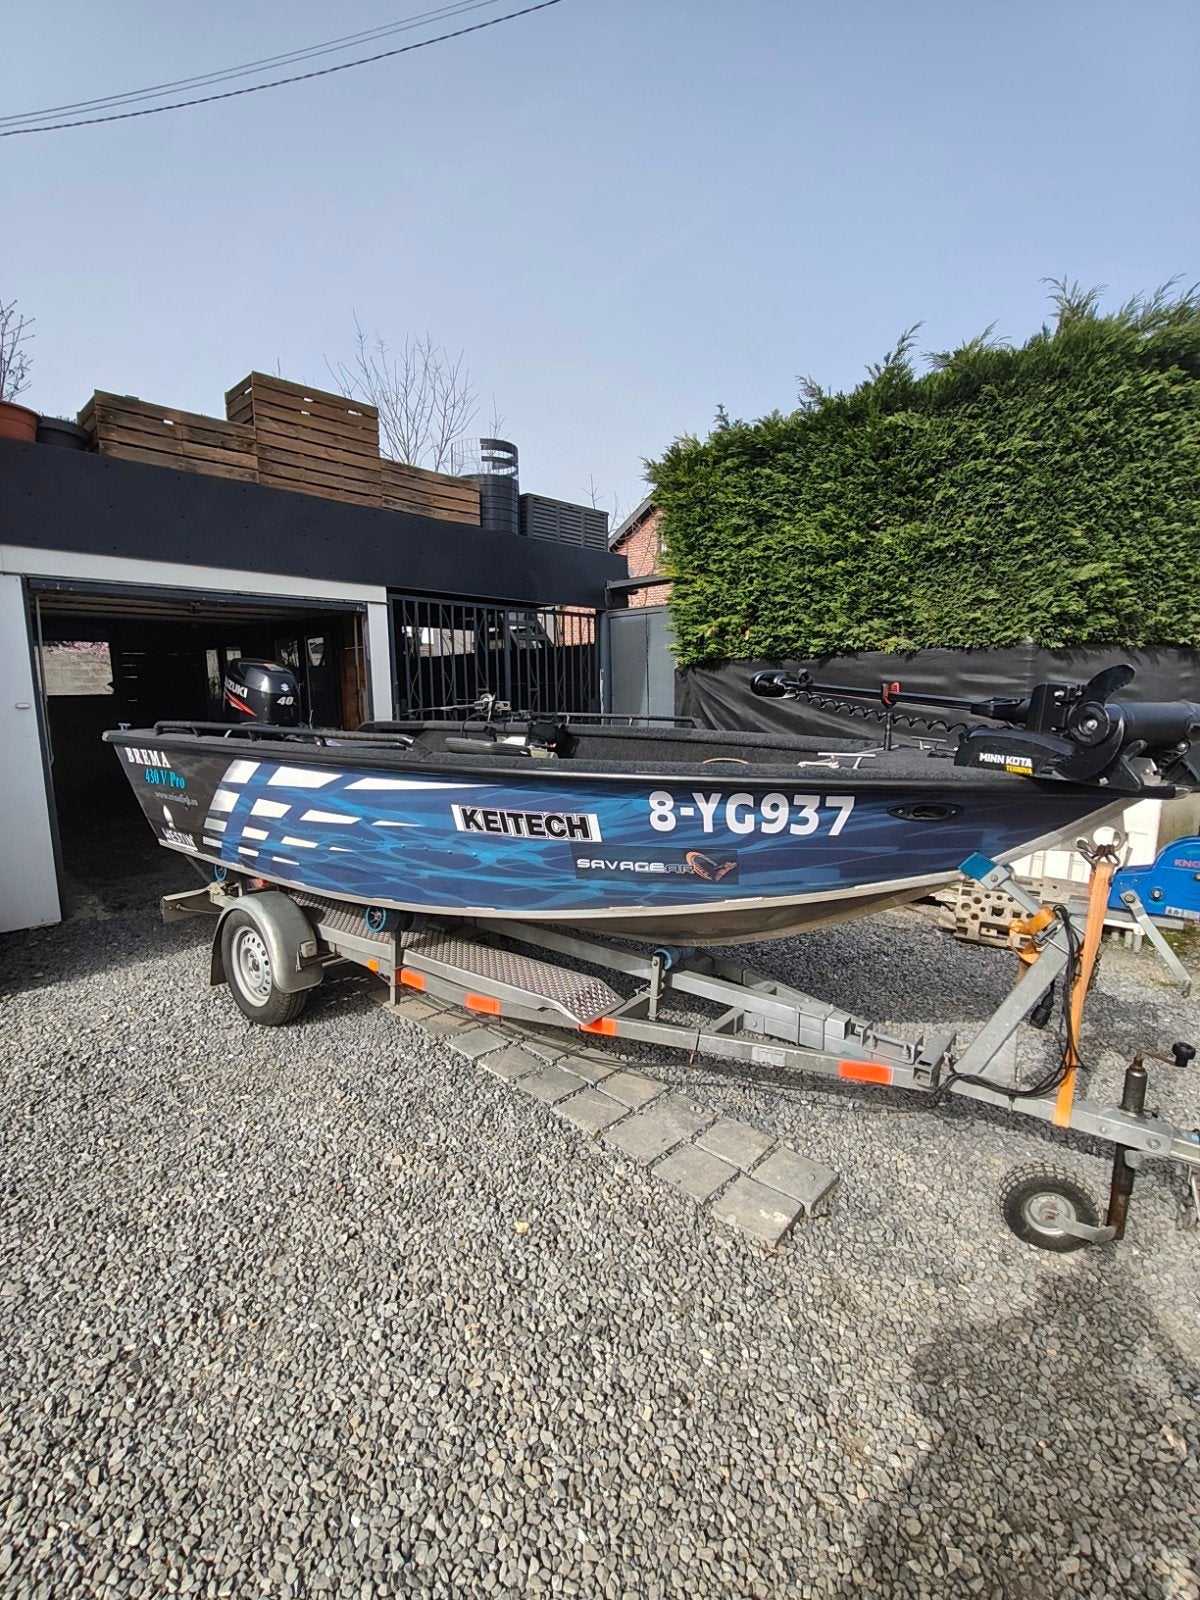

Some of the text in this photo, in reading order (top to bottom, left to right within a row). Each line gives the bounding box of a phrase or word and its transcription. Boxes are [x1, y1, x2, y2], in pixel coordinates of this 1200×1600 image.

[277, 697, 294, 705] 40
[125, 747, 171, 768] BREMA
[980, 752, 1033, 768] MINN KOTA
[145, 768, 185, 789] 430 V Pro
[460, 807, 590, 839] KEITECH
[649, 791, 855, 836] 8-YG937
